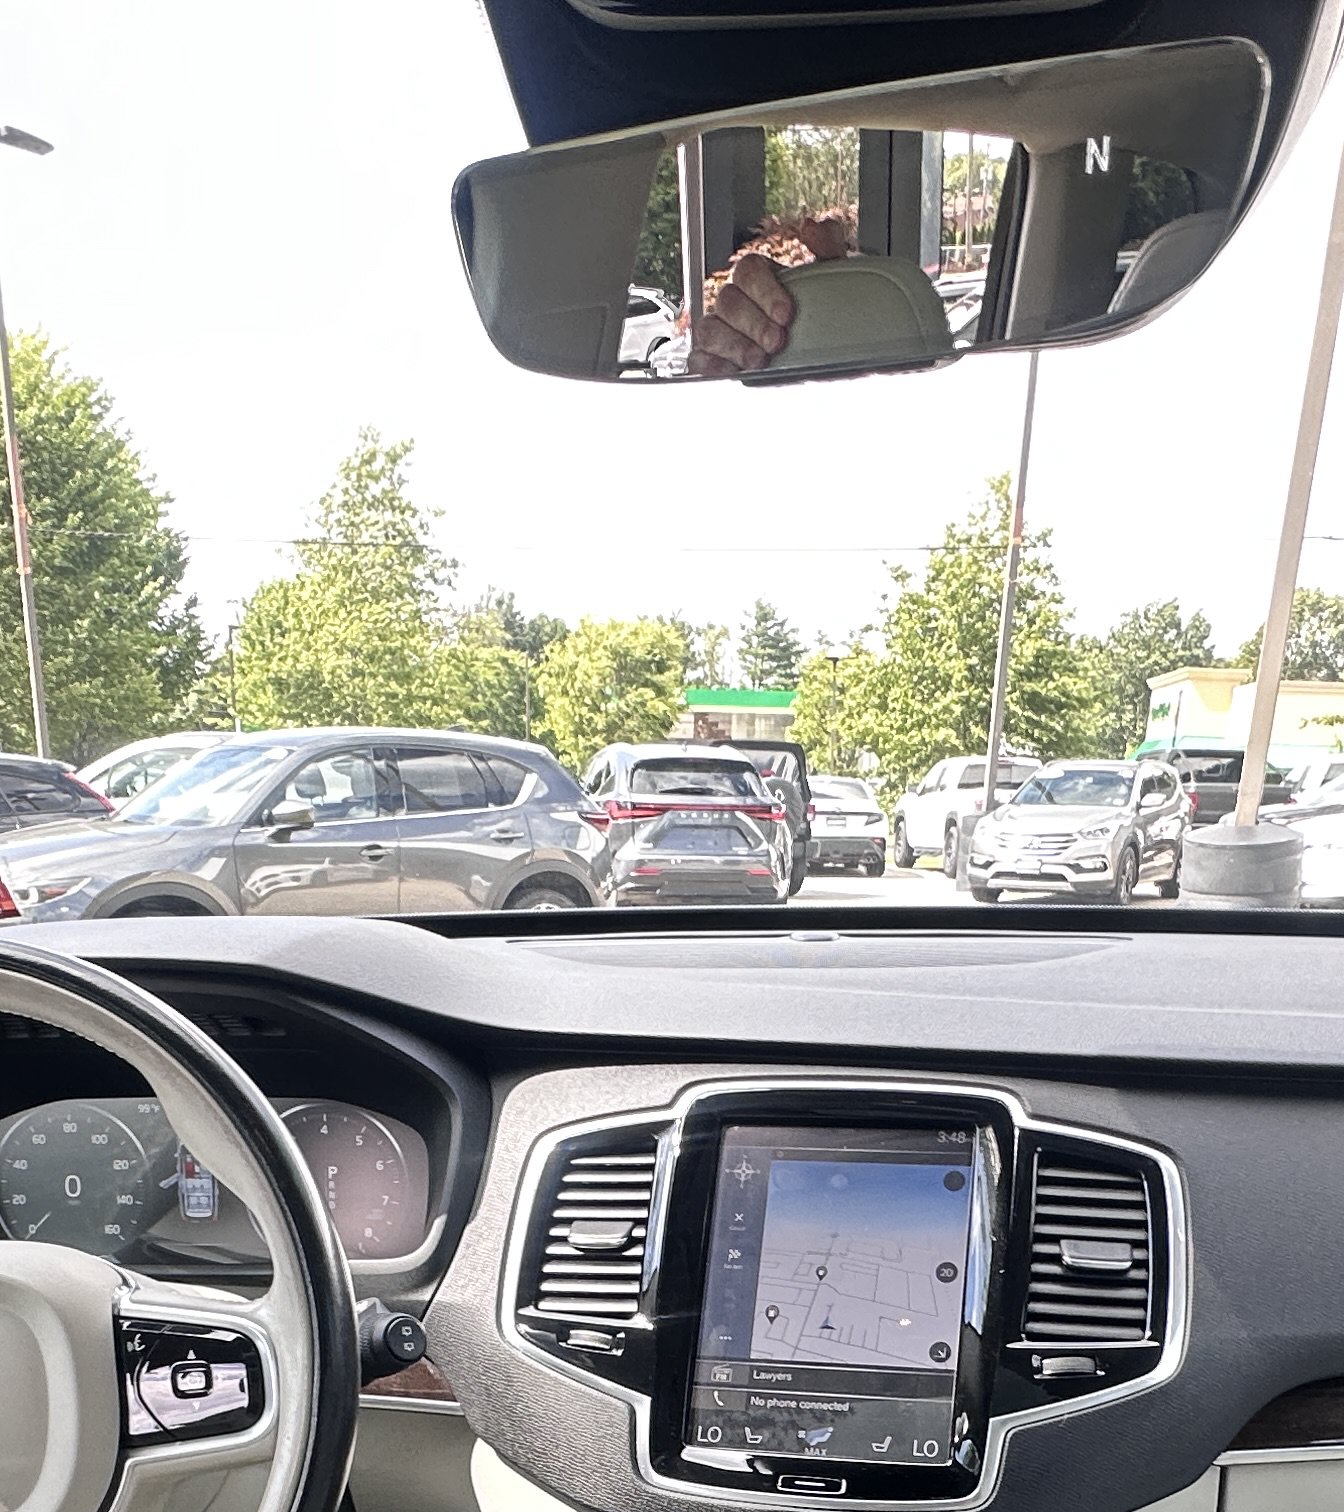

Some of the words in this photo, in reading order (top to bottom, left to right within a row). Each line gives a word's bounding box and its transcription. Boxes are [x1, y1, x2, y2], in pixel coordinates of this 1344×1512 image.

[1085, 135, 1111, 174] N
[63, 1122, 77, 1133] 80
[320, 1124, 329, 1135] 4
[32, 1134, 46, 1144] 60
[91, 1134, 108, 1145] 100
[355, 1135, 363, 1146] 5
[13, 1160, 28, 1170] 40
[376, 1160, 384, 1171] 6
[328, 1166, 338, 1179] P
[64, 1174, 81, 1197] 0
[12, 1194, 27, 1205] 20
[382, 1195, 389, 1206] 7
[28, 1224, 37, 1234] 0
[364, 1227, 373, 1238] 8
[752, 1370, 793, 1383] Lawyers
[750, 1396, 766, 1407] No
[767, 1398, 797, 1410] phone
[799, 1400, 850, 1412] connected
[696, 1425, 722, 1443] LO
[804, 1447, 828, 1457] MAX
[912, 1440, 939, 1457] LO
